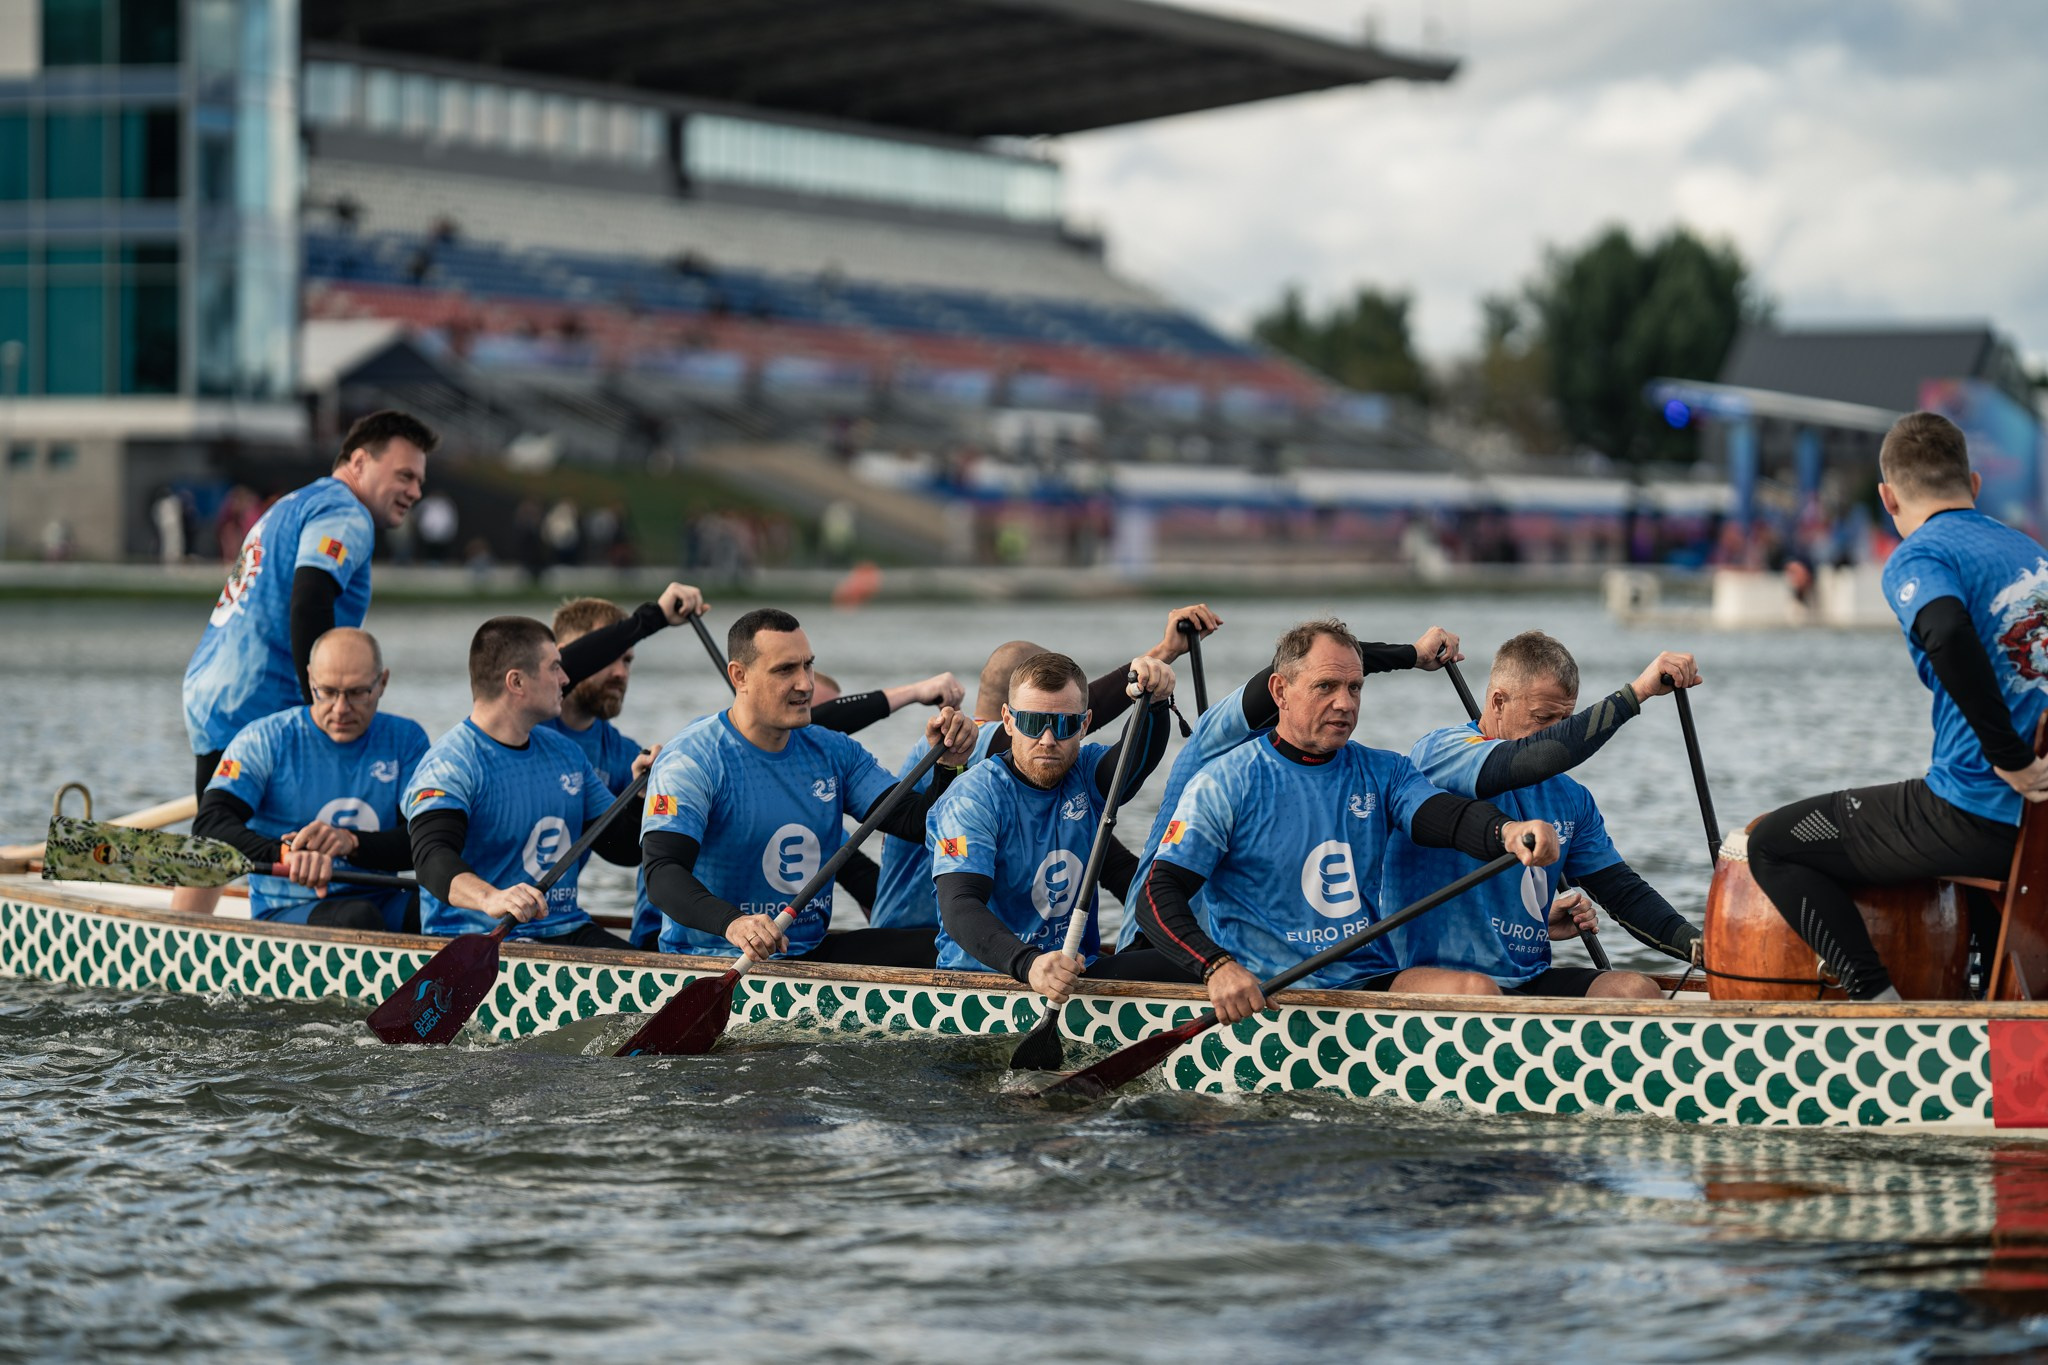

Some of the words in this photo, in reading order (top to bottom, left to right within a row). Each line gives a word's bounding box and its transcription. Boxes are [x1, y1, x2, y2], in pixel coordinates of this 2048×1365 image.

[551, 888, 577, 902] REPA
[802, 894, 832, 914] EPAR
[1285, 926, 1343, 944] EURO
[1491, 917, 1535, 940] EURO
[1508, 943, 1525, 953] CAR
[413, 1007, 435, 1030] АВТО
[417, 1012, 442, 1038] НОРД
